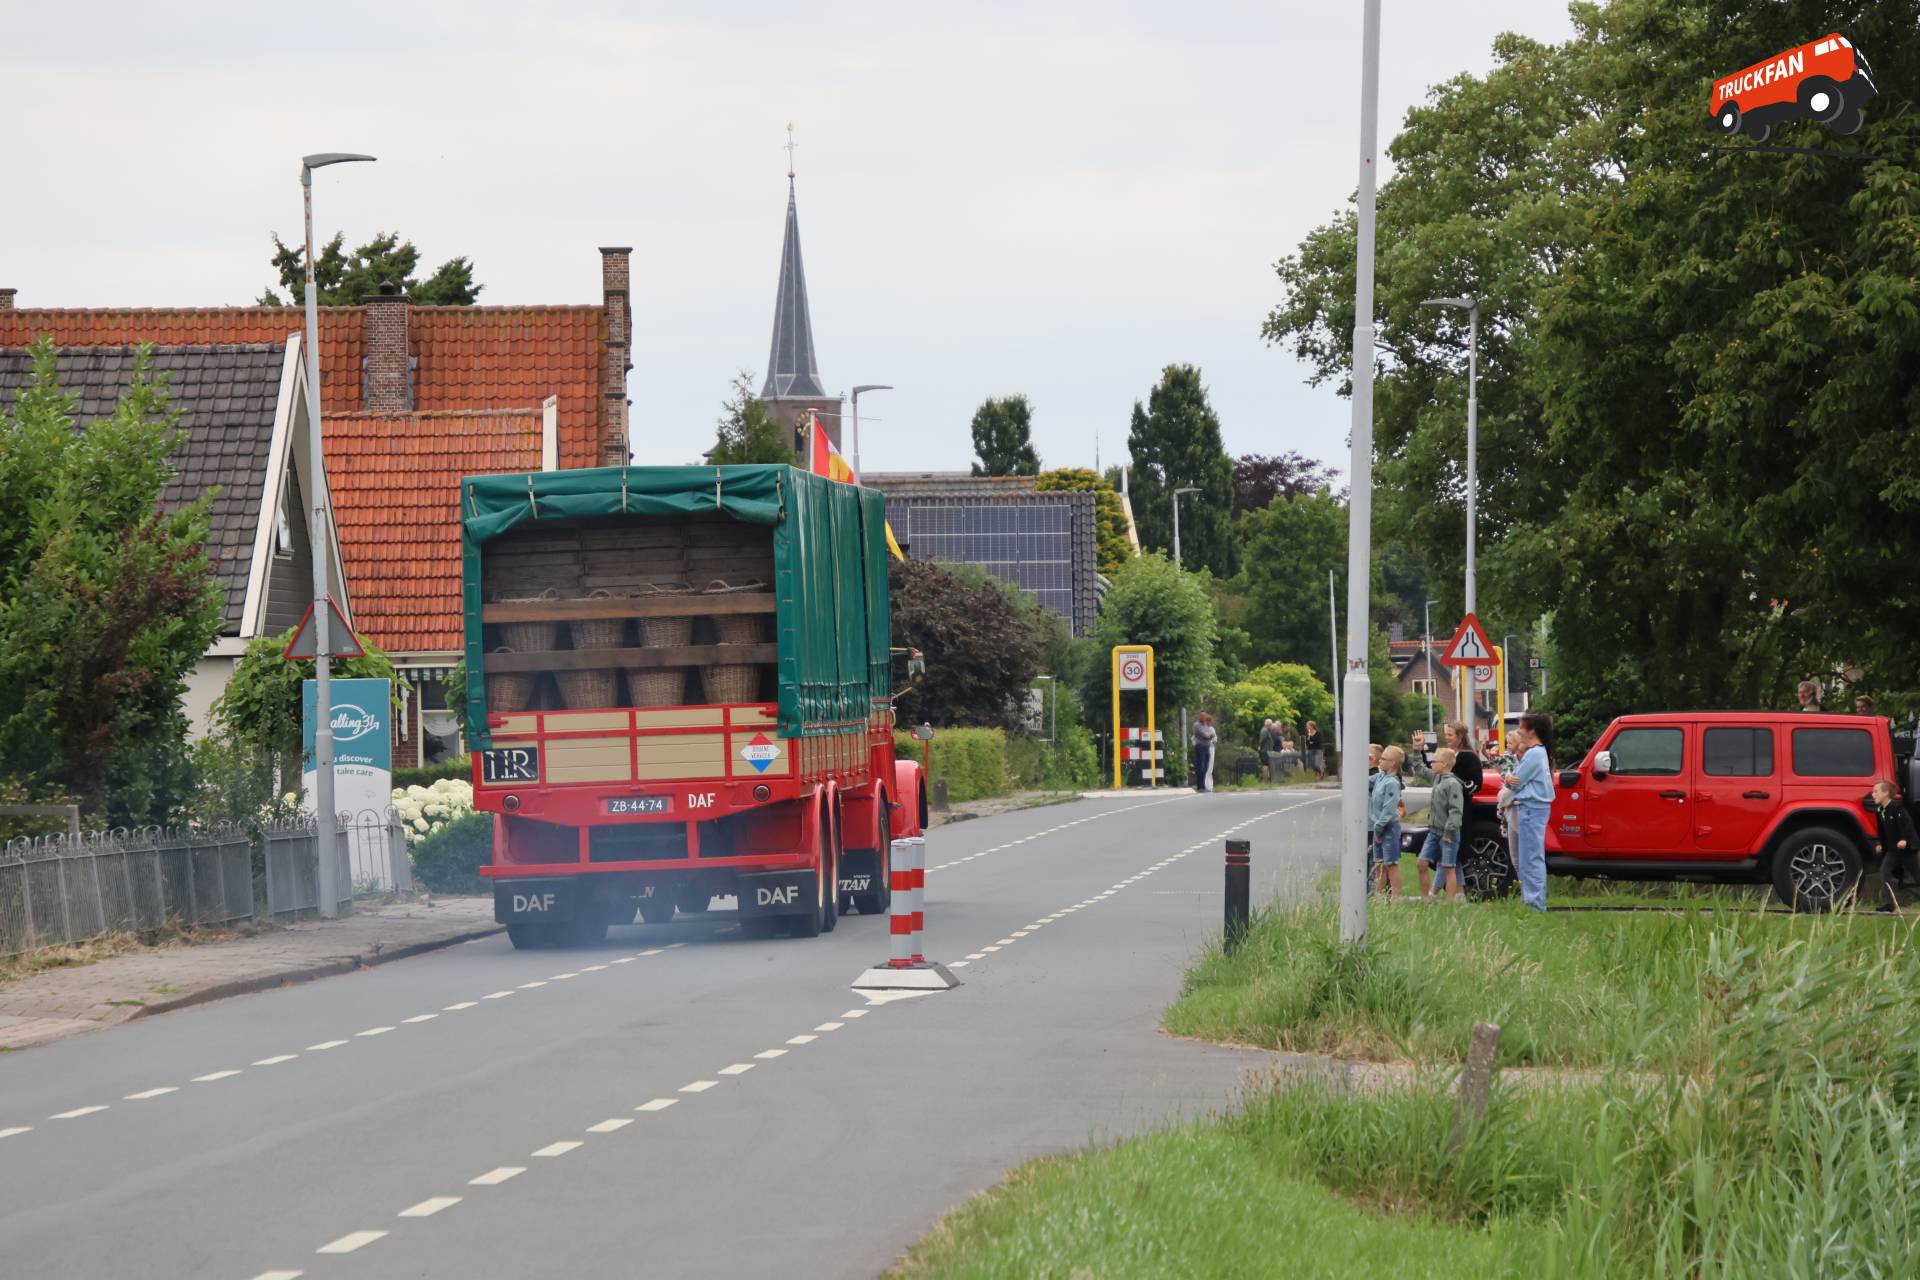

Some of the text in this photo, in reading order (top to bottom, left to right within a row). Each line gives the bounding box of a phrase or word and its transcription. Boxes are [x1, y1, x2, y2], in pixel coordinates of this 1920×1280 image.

[1126, 666, 1141, 675] 30
[1475, 667, 1489, 677] 30
[339, 754, 373, 764] discover
[336, 766, 374, 777] take care
[688, 792, 716, 808] DAF
[612, 800, 663, 812] ZB-44-74
[1559, 823, 1581, 832] Jeep
[757, 886, 799, 906] DAF
[513, 894, 555, 913] DAF
